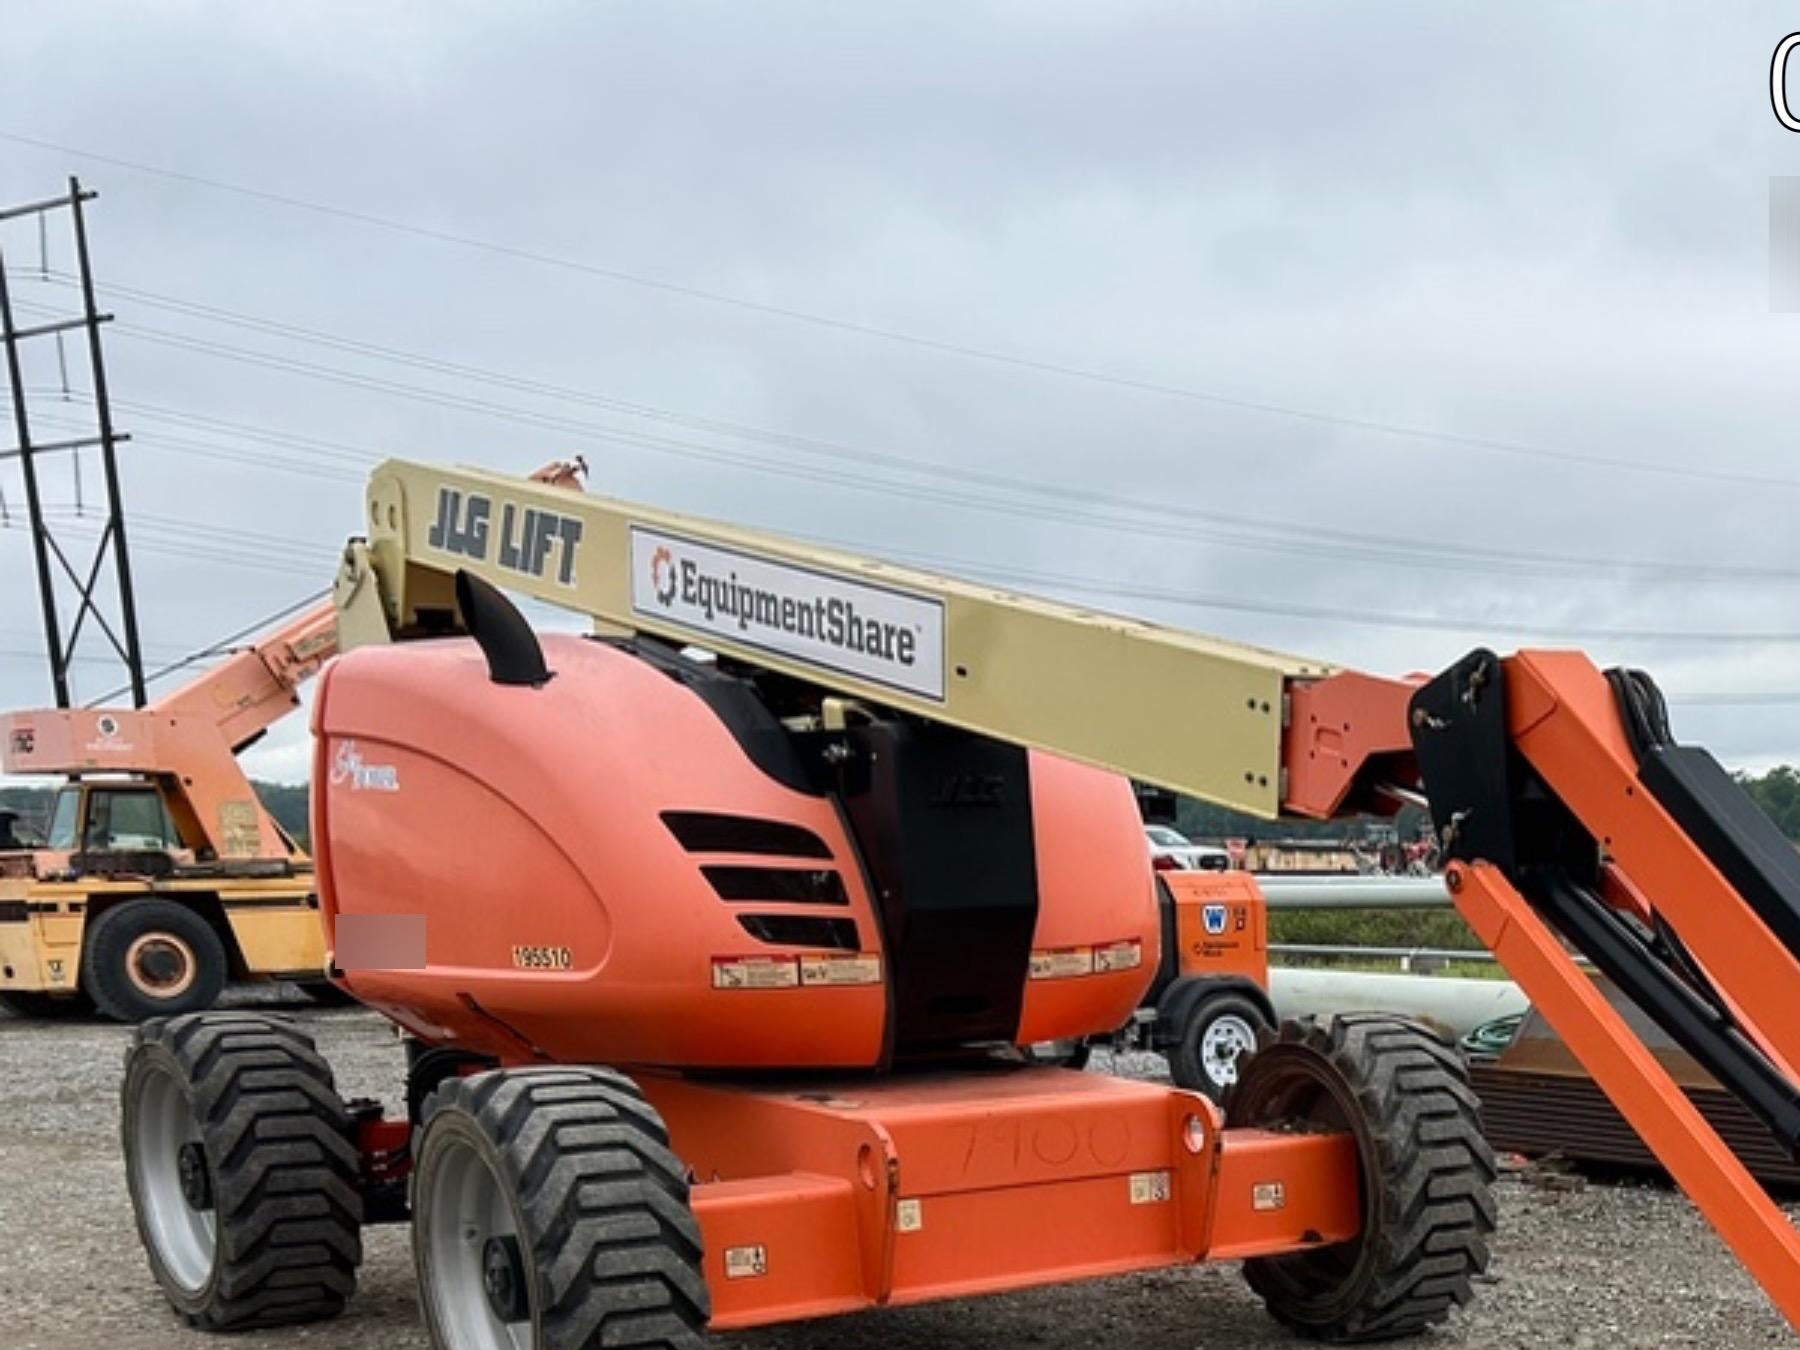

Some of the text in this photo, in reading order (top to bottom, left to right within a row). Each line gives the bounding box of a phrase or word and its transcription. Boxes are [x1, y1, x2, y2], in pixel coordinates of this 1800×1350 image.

[428, 486, 583, 585] JLG LIFT
[680, 558, 916, 667] EquipmentShare
